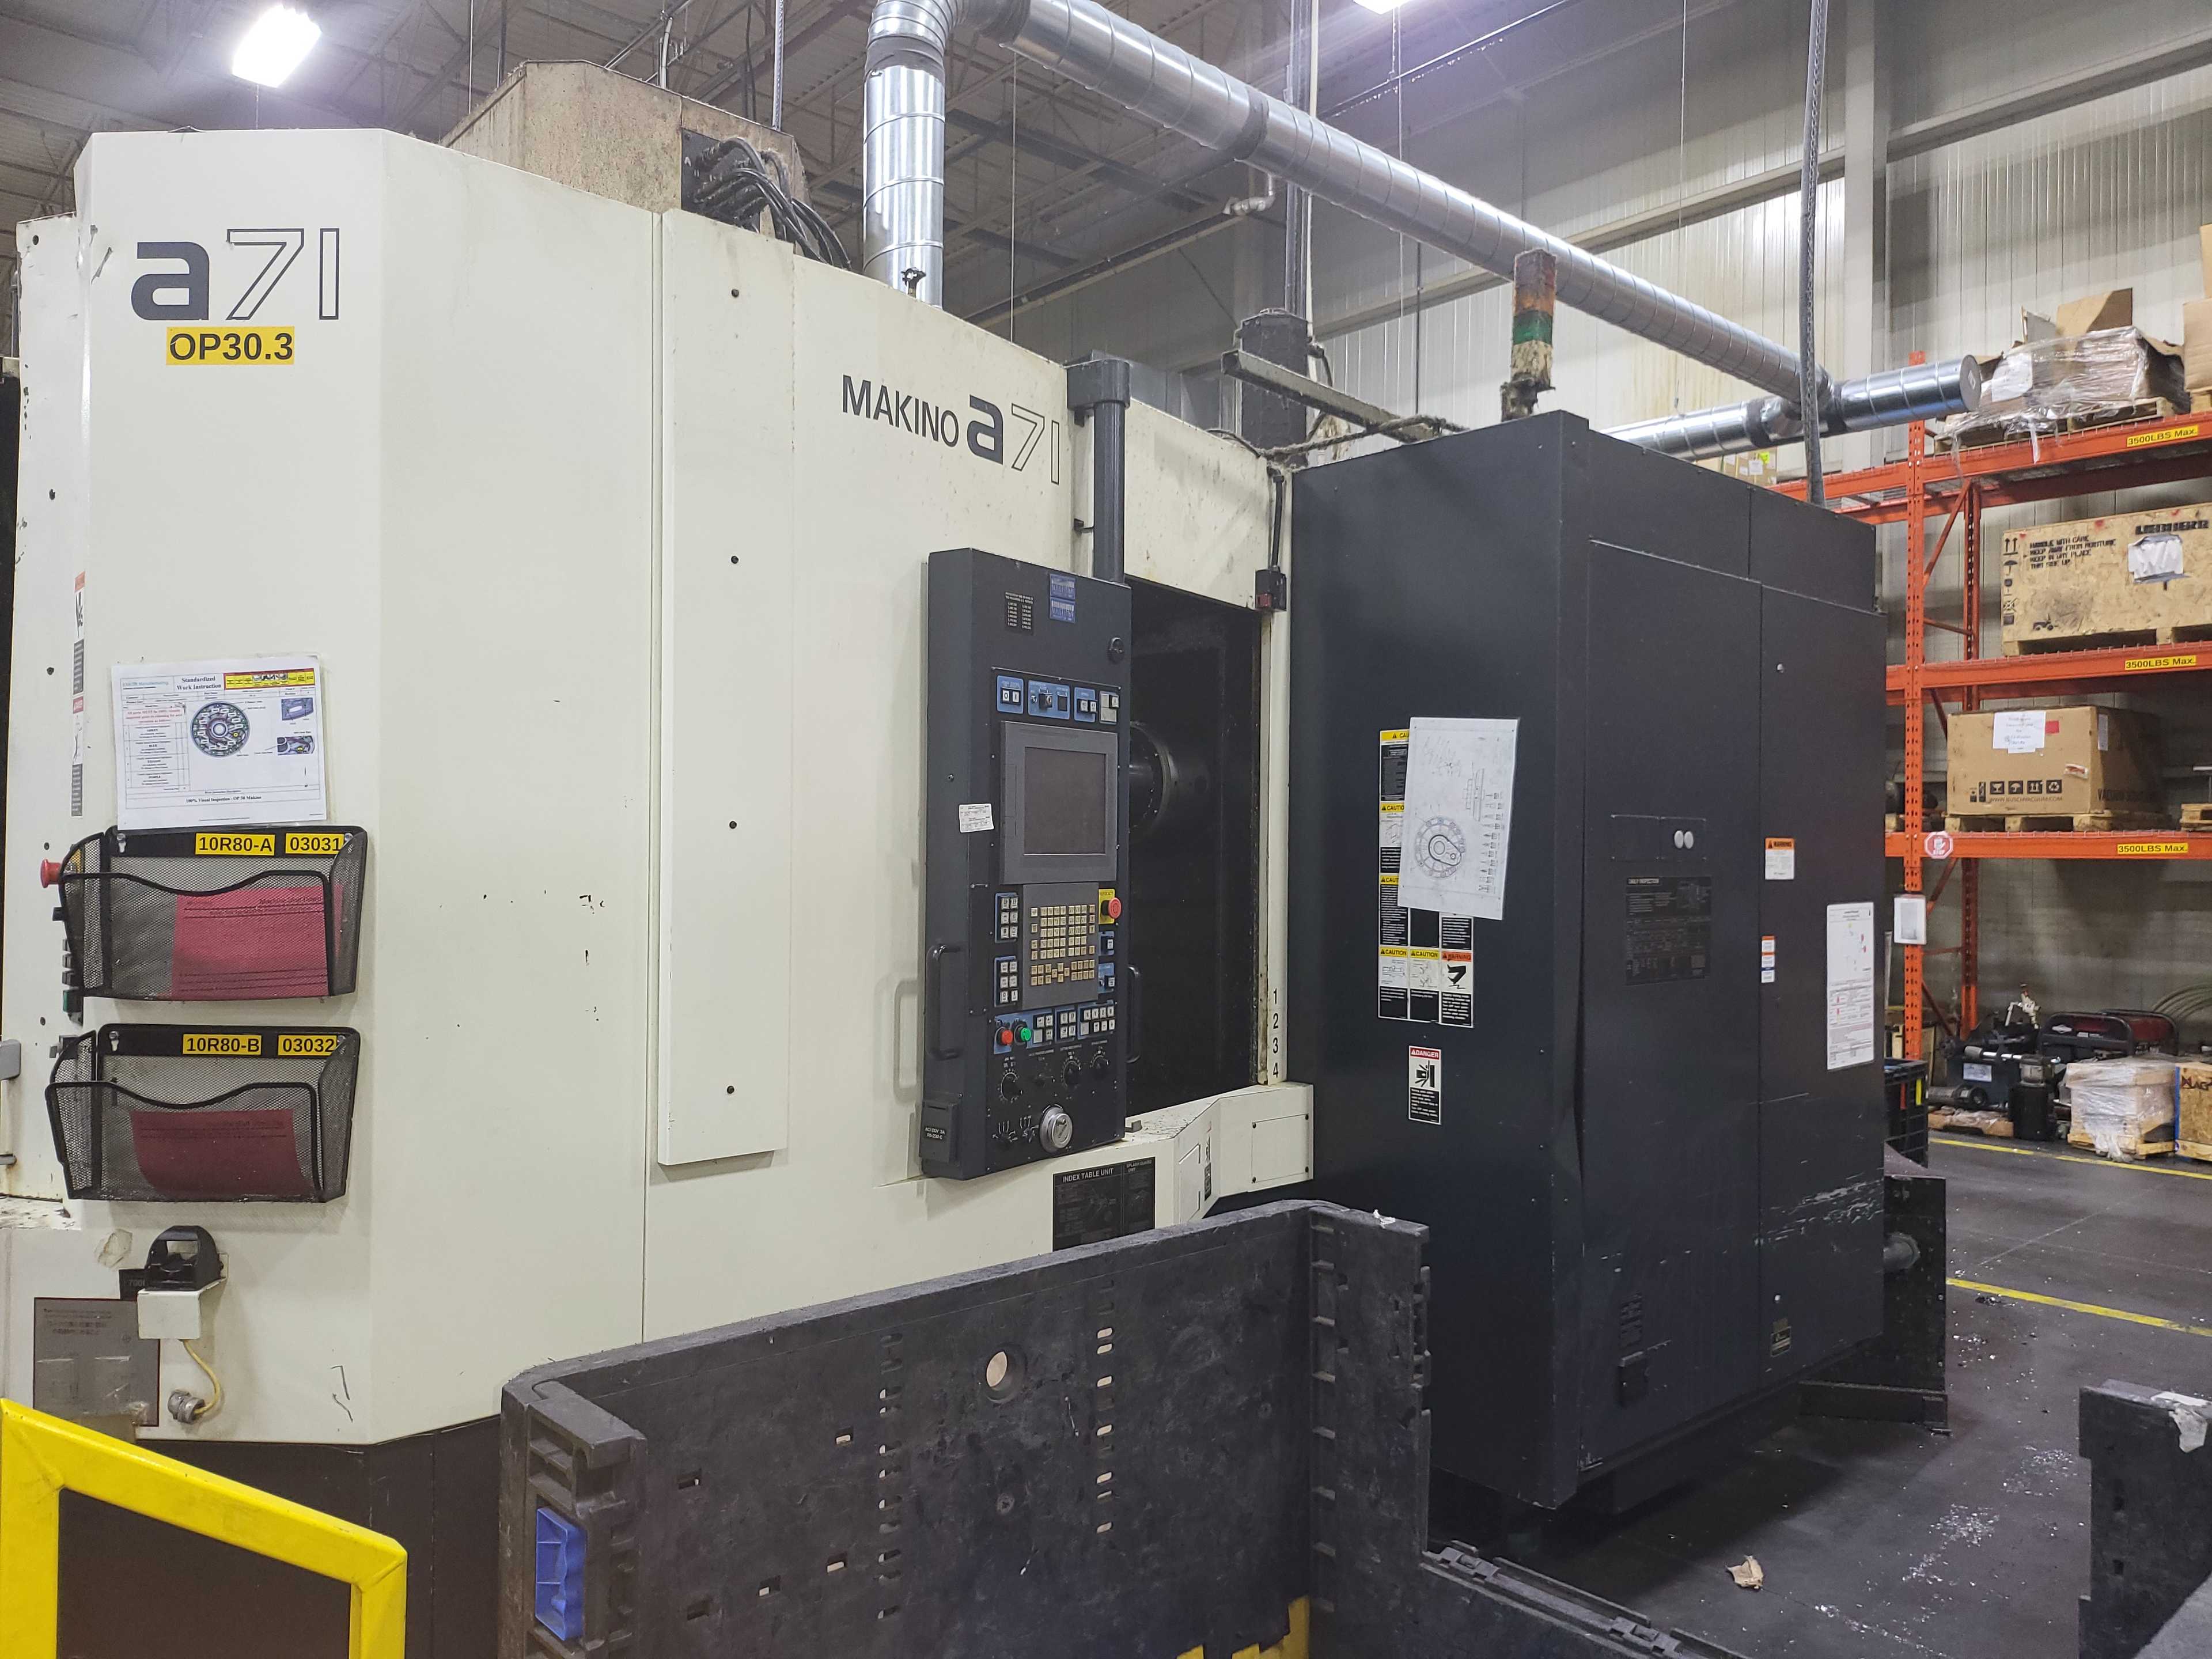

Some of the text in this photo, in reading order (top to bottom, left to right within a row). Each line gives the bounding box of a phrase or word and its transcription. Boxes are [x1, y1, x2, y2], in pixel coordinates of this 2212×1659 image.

[131, 228, 340, 321] a71
[169, 332, 293, 361] OP30.3
[842, 373, 1060, 486] MAKINO a71
[2128, 433, 2171, 445] 3500LBS
[2126, 659, 2170, 669] 3500LBS
[198, 836, 341, 852] 10R80-A 03031
[2118, 845, 2162, 853] 3500LBS
[1273, 988, 1278, 1004] 1
[1272, 1013, 1279, 1029] 2
[187, 1038, 335, 1052] 10R80-B 03032
[1272, 1037, 1279, 1054] 3
[1416, 1050, 1439, 1058] DANGER
[1272, 1062, 1279, 1078] 4
[1063, 1168, 1114, 1183] INDEX TABLE UNIT
